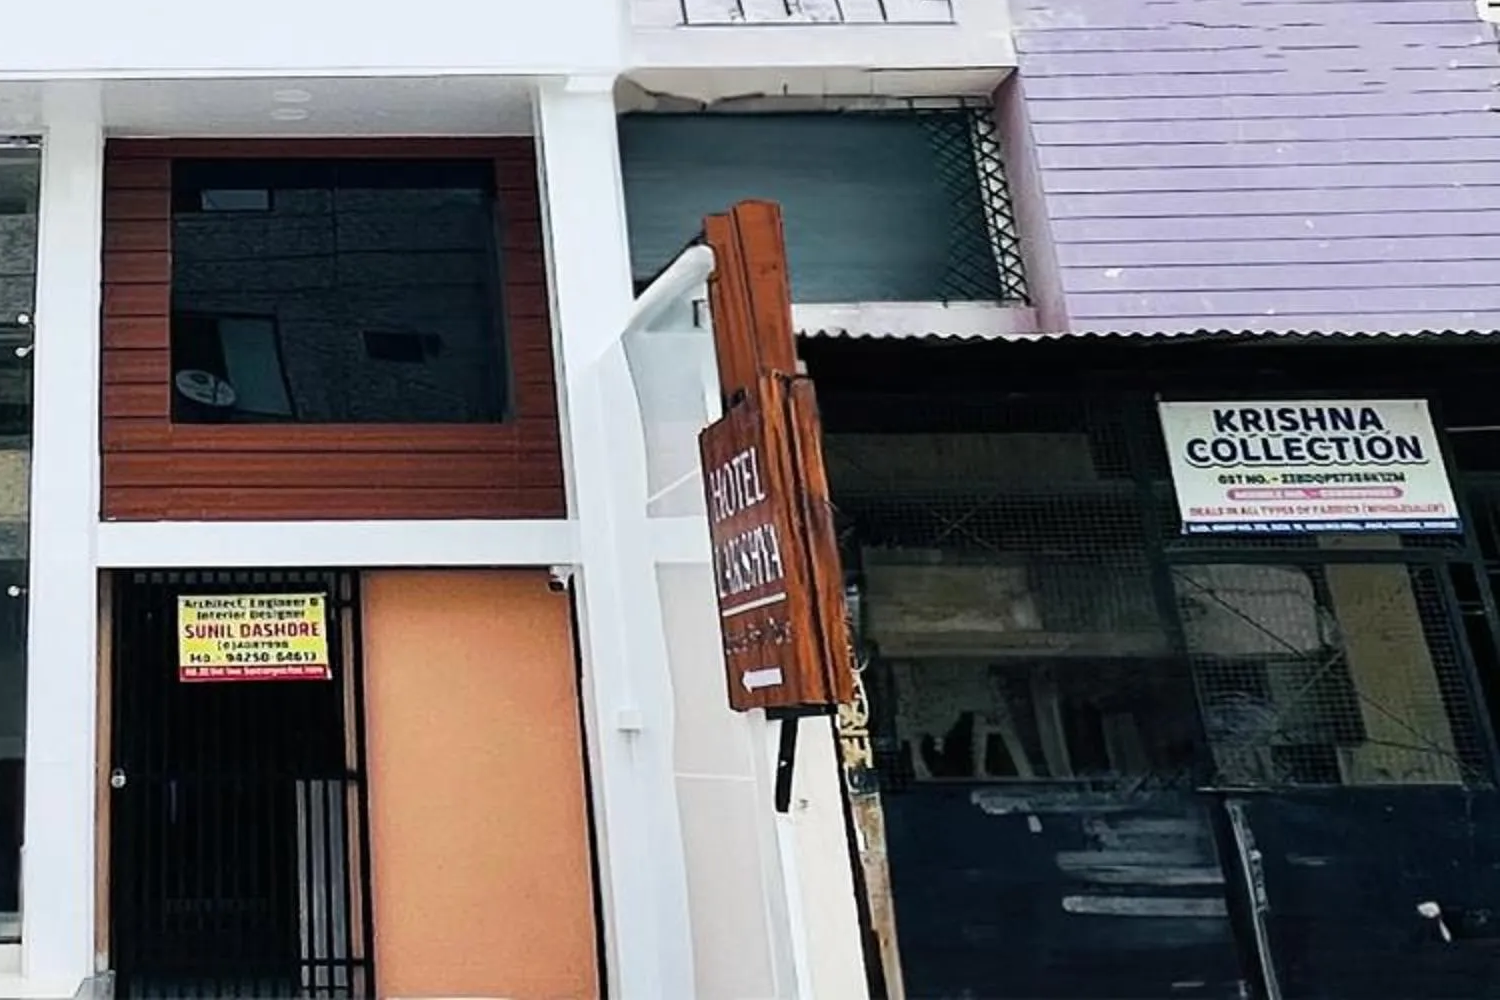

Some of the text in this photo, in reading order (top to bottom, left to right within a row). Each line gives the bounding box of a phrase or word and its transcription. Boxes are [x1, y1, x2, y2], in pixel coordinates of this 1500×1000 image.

[1213, 407, 1384, 432] KRISHNA
[1186, 435, 1424, 463] COLLECTION
[708, 447, 766, 523] HOTEL
[249, 609, 304, 620] Designer
[184, 622, 320, 639] SUNIL DASHORE
